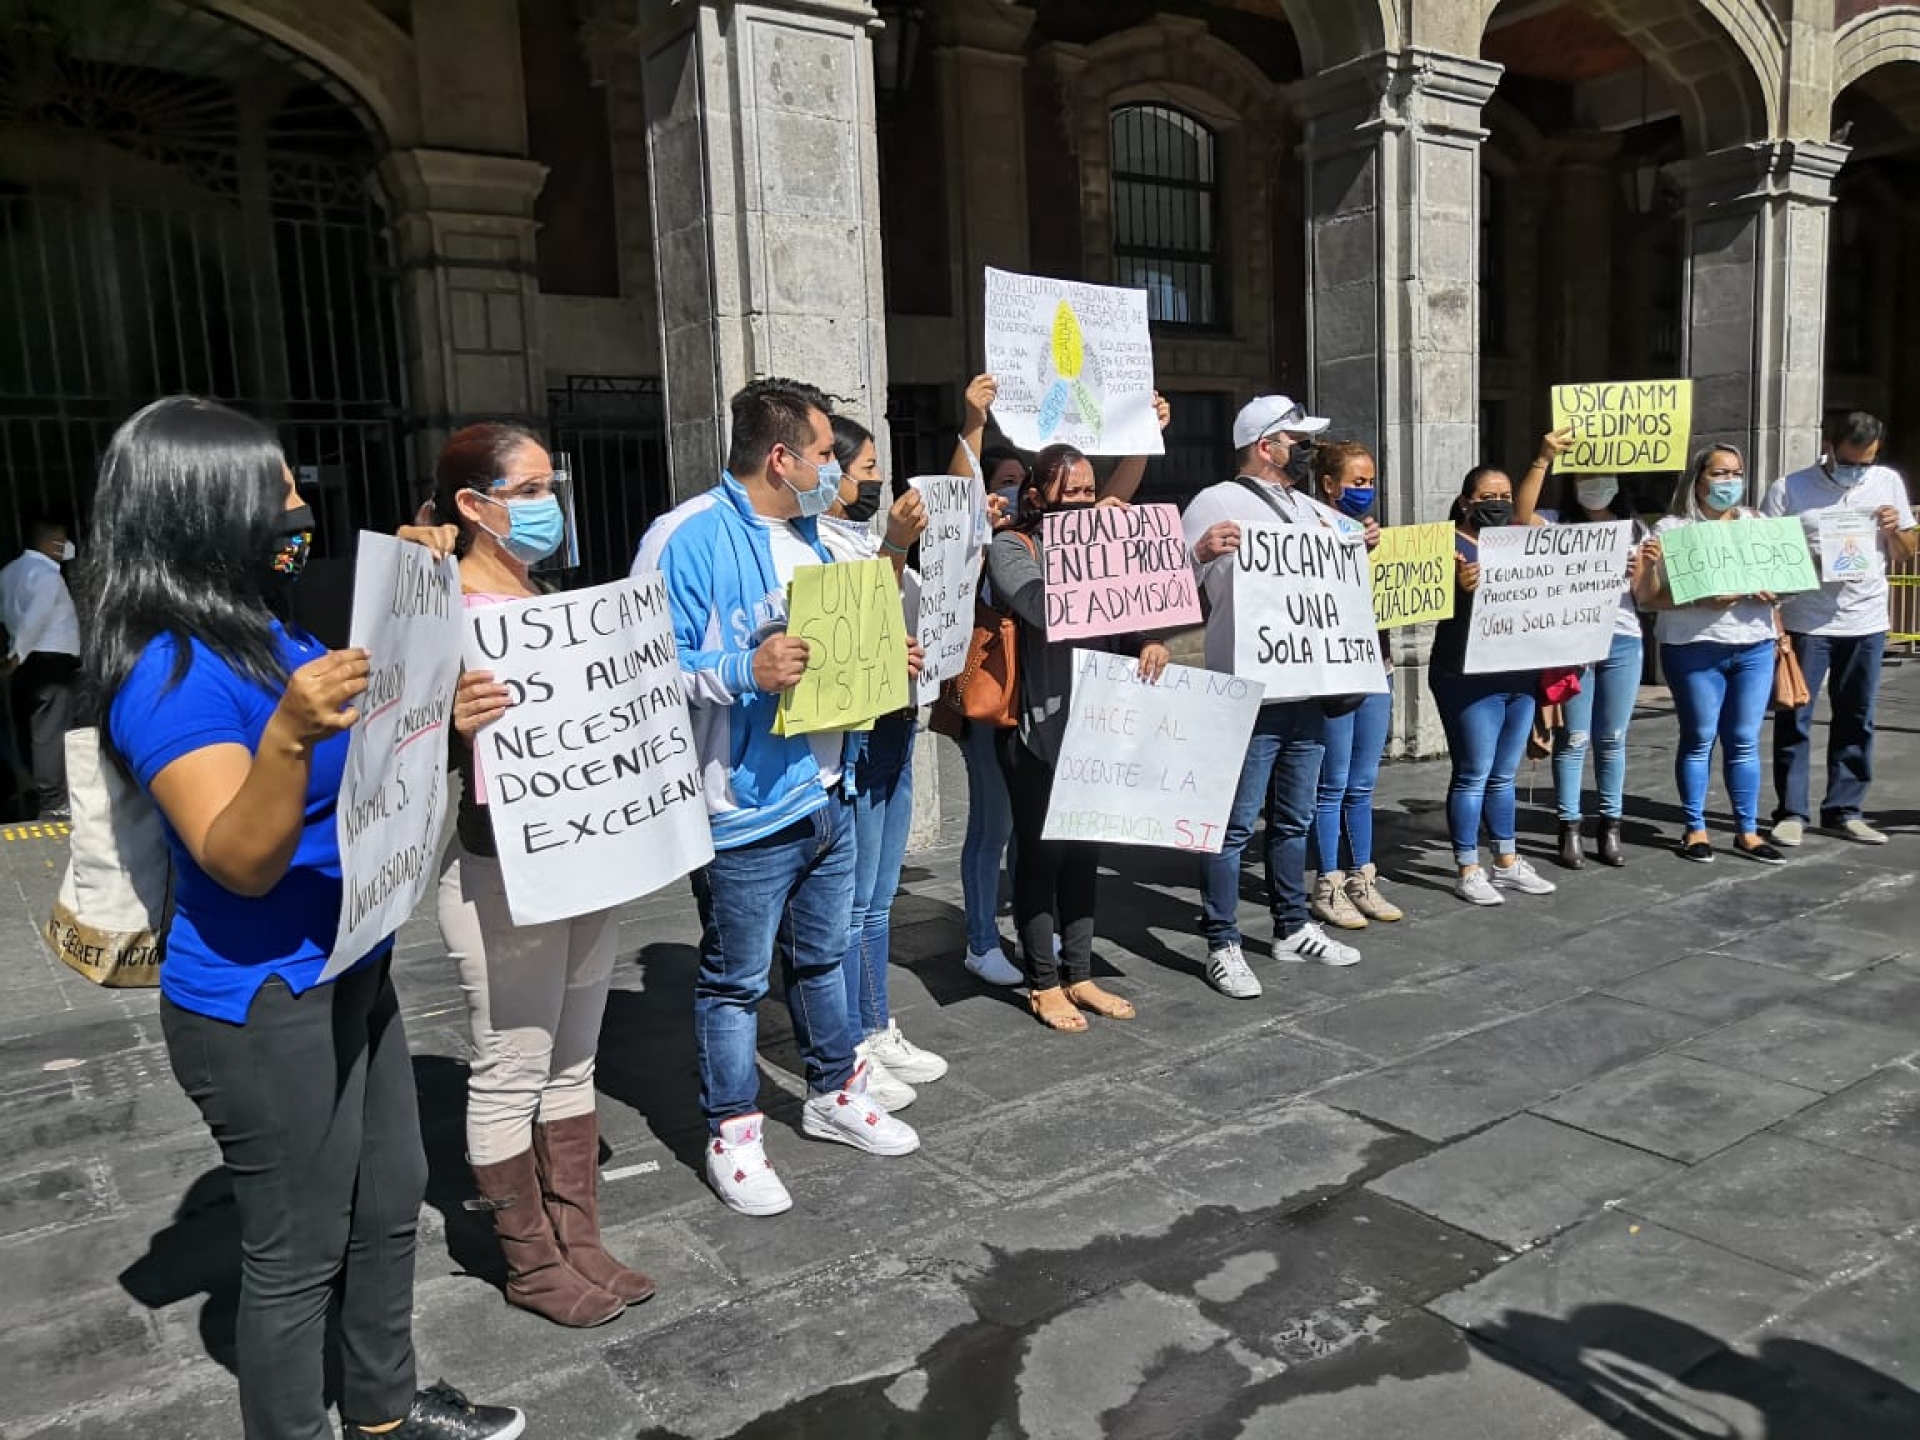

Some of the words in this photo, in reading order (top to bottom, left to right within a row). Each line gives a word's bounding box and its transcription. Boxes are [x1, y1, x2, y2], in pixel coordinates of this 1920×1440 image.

[1559, 385, 1677, 414] USICAMM
[1567, 412, 1672, 439] PEDIMOS
[1561, 440, 1671, 468] EQUIDAD
[1045, 506, 1172, 549] IGUALDAD
[1237, 527, 1361, 588] USICAMM
[1373, 557, 1444, 592] PEDIMOS
[1484, 565, 1554, 585] IGUALDAD
[1564, 561, 1587, 577] EN
[1594, 559, 1614, 573] EL
[1665, 542, 1805, 576] IGUALDAD
[821, 559, 889, 615] UNA
[1046, 590, 1080, 627] DE
[1087, 574, 1193, 624] ADMISIÓN
[1547, 584, 1567, 598] DE
[1286, 592, 1340, 629] UNA
[1372, 587, 1446, 623] GUALDAD
[799, 609, 893, 671] SOLA
[1324, 637, 1376, 664] LISTA
[1206, 674, 1248, 699] NO
[493, 680, 682, 761] NECESITAN
[1083, 704, 1139, 736] HACE
[1156, 714, 1187, 741] AL
[494, 725, 688, 805] DOCENTES
[1160, 766, 1197, 792] LA
[1173, 819, 1219, 851] SI
